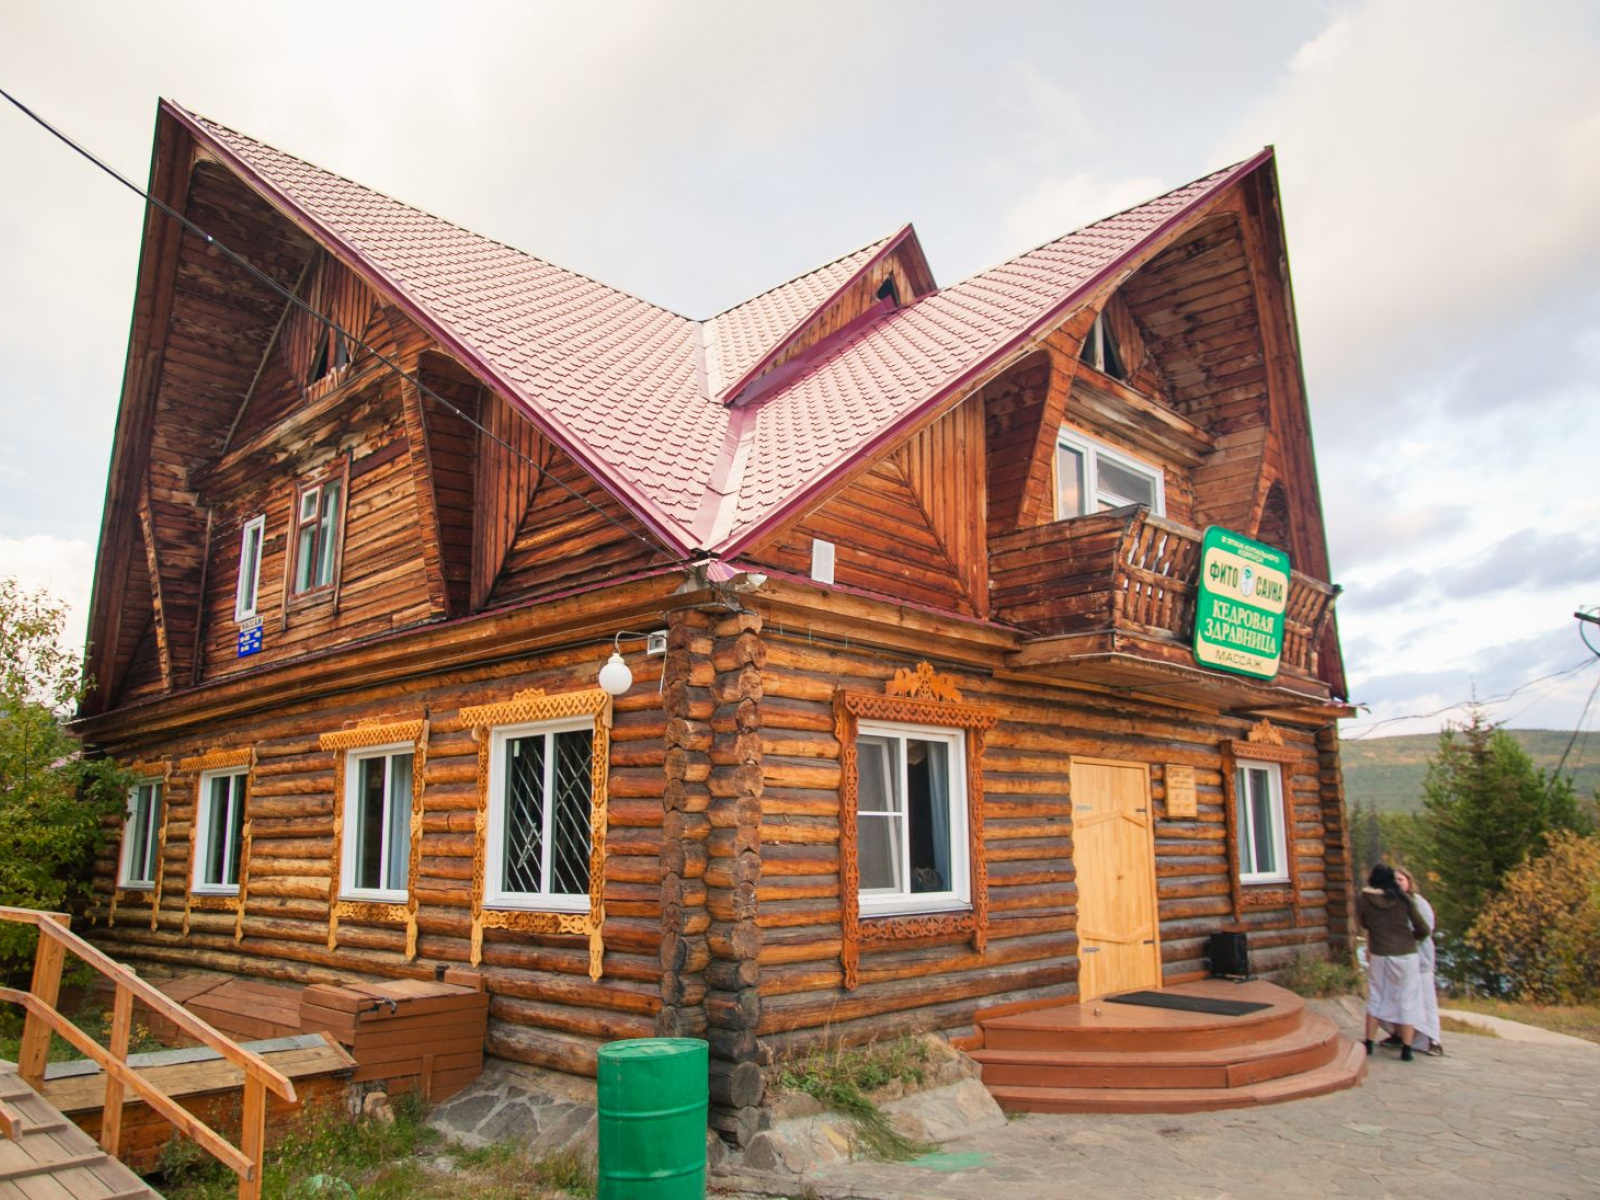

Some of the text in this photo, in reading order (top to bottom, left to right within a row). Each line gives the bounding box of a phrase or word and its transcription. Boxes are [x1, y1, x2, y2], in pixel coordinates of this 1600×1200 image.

[1210, 561, 1283, 603] ФИТО САУНА
[1212, 600, 1275, 634] КЕДРОВАЯ
[1204, 619, 1276, 655] ЗДРАВНИЦА
[1215, 650, 1263, 669] МАССАЖ
